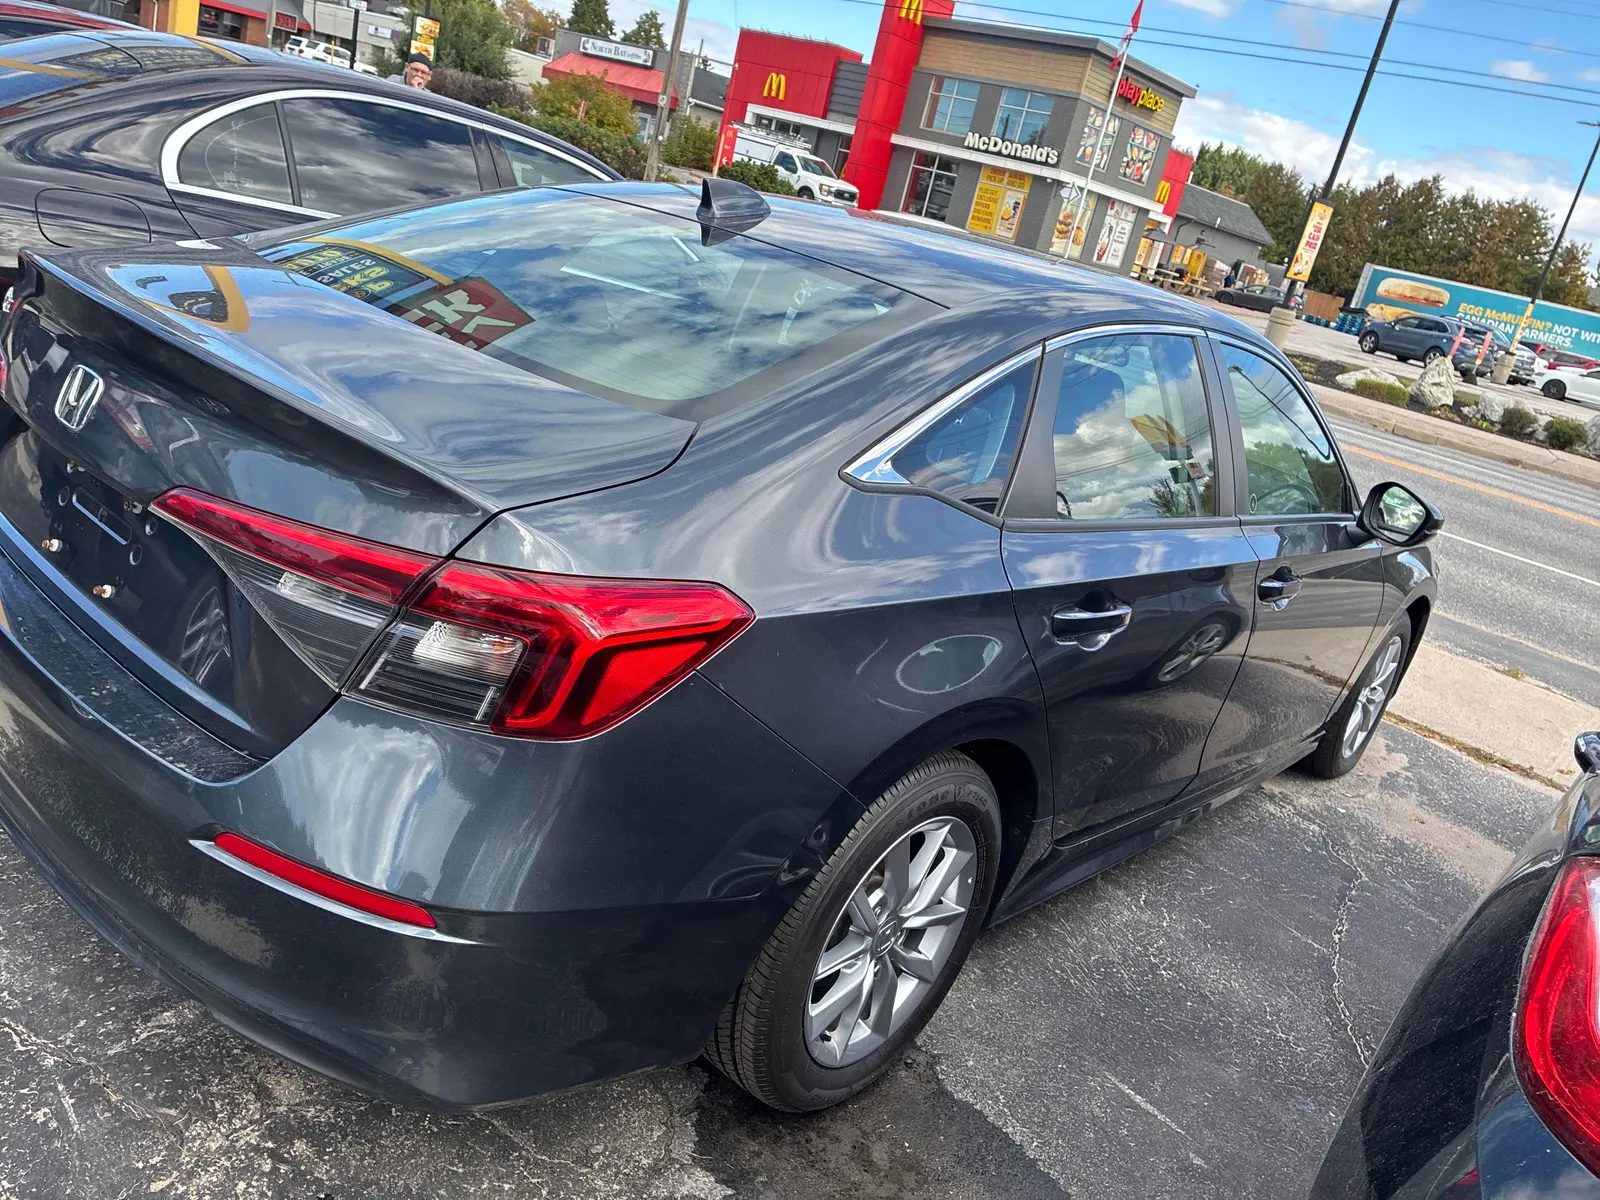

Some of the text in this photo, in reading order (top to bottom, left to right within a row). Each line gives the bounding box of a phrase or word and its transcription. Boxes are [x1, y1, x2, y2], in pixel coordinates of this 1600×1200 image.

[1116, 77, 1165, 112] playplace
[964, 132, 1058, 164] McDonald's
[1458, 302, 1483, 317] EGG
[1485, 308, 1553, 331] McMUIN?
[1552, 323, 1579, 338] NOT
[1520, 327, 1573, 348] ARMERS.
